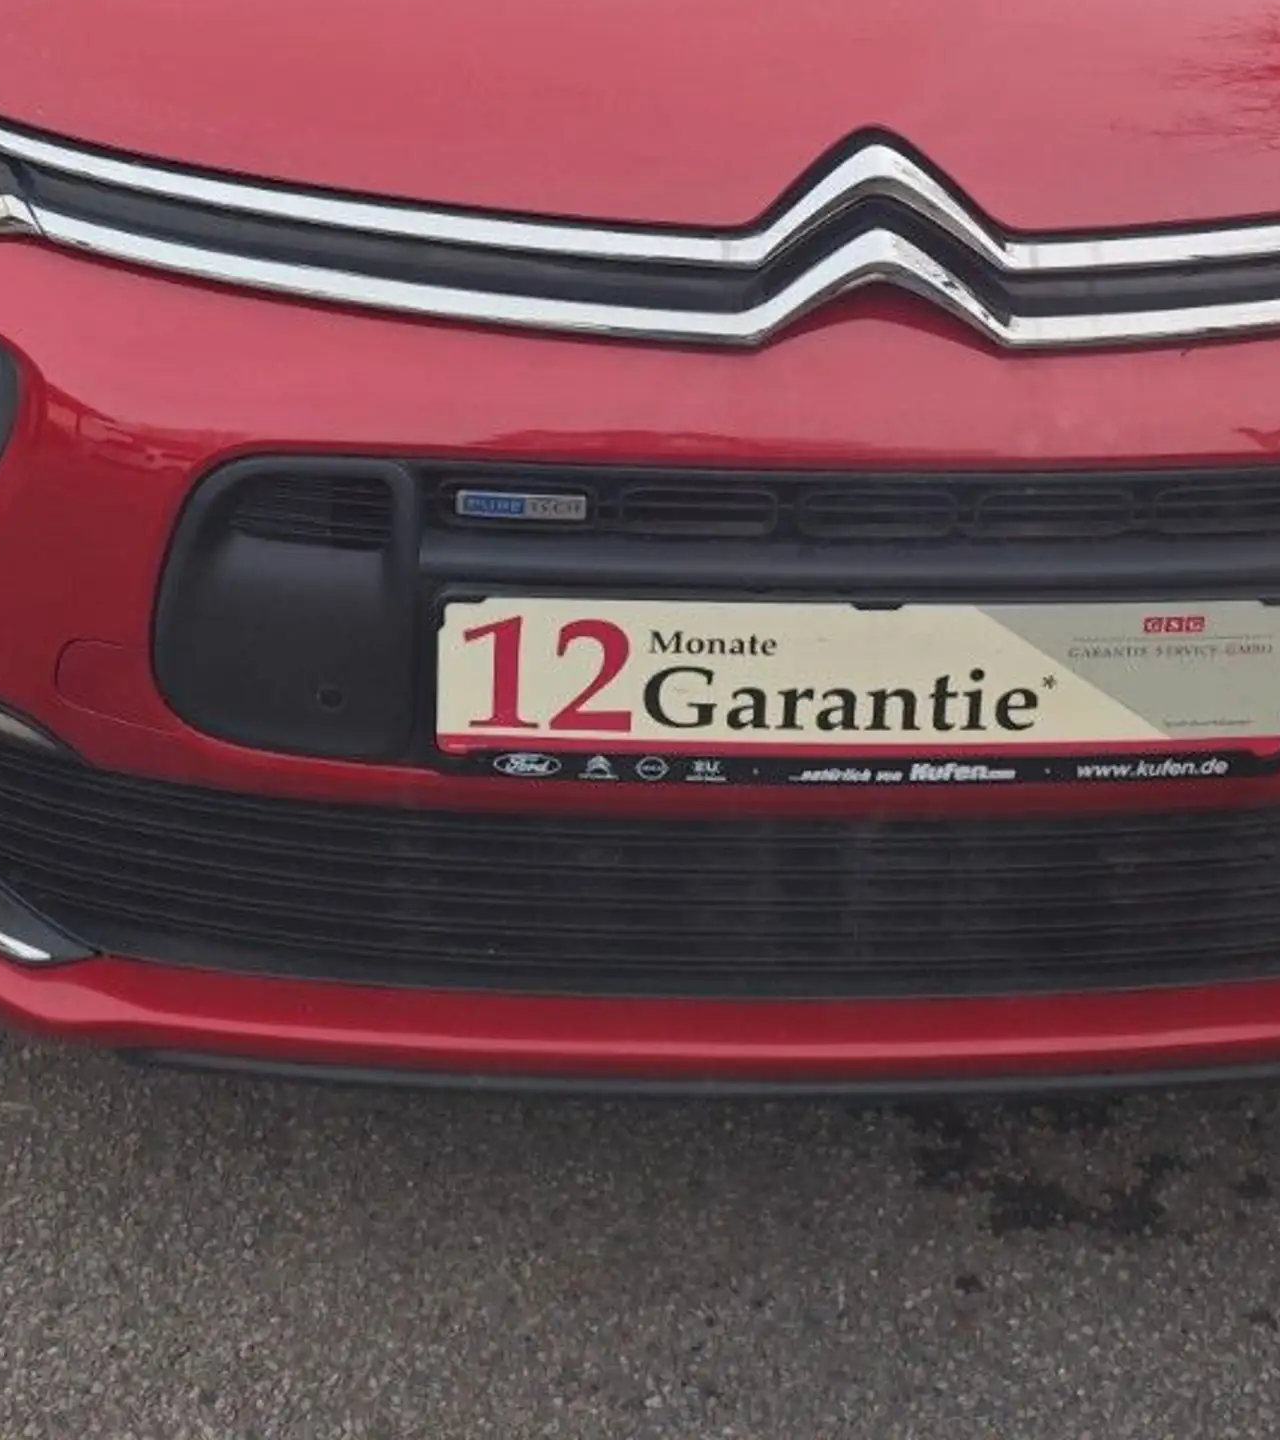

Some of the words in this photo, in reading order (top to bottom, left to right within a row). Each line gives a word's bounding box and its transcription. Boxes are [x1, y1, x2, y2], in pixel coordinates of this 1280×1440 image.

[647, 630, 778, 657] Monate
[463, 615, 632, 733] 12
[1076, 757, 1230, 778] www.kufen.de
